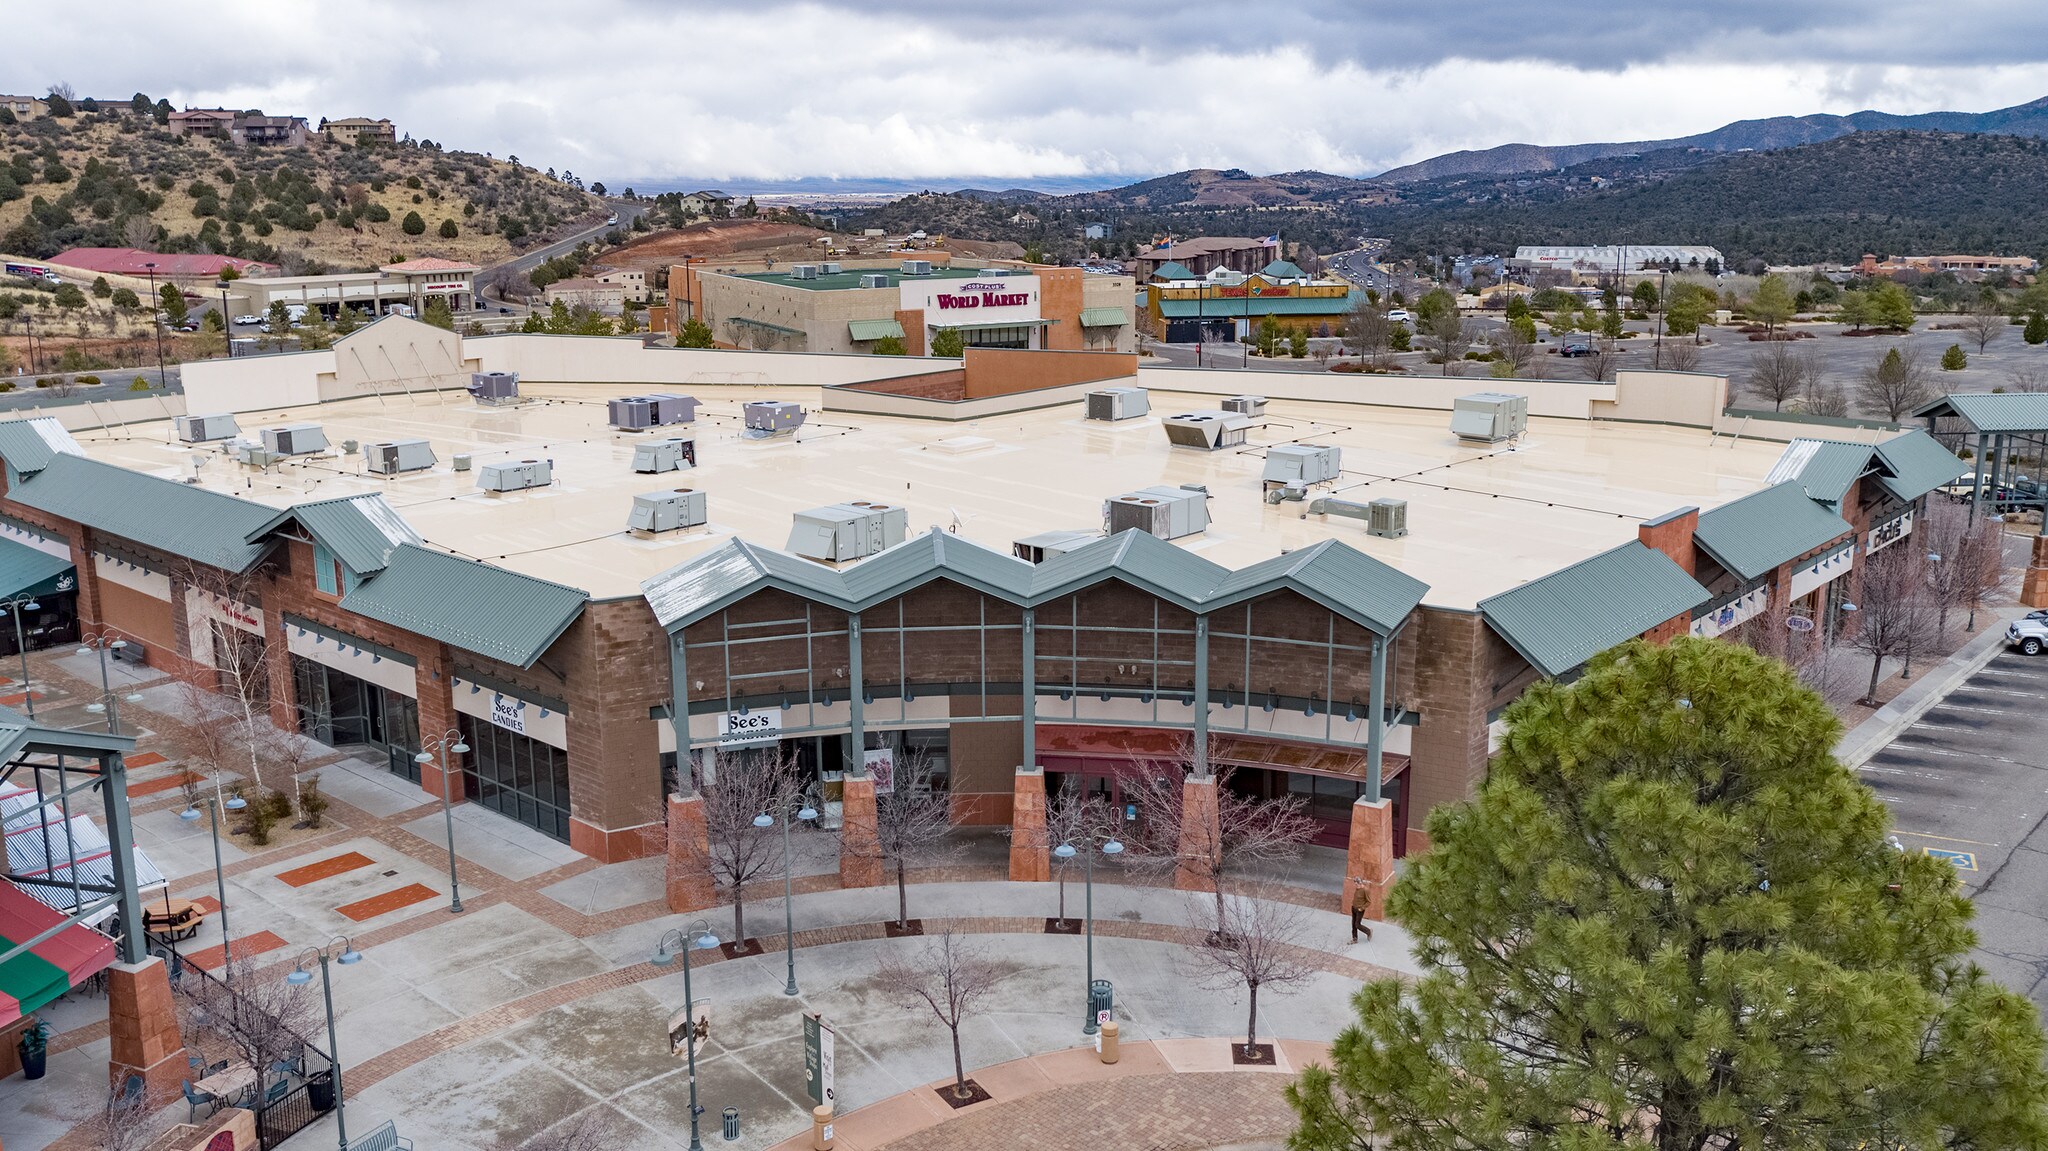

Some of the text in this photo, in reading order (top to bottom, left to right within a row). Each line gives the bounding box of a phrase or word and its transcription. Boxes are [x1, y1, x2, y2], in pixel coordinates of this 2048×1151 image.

[937, 292, 1029, 309] WORLD MARKET
[494, 700, 518, 719] See's
[492, 712, 523, 732] CANDIES
[730, 715, 769, 730] See's
